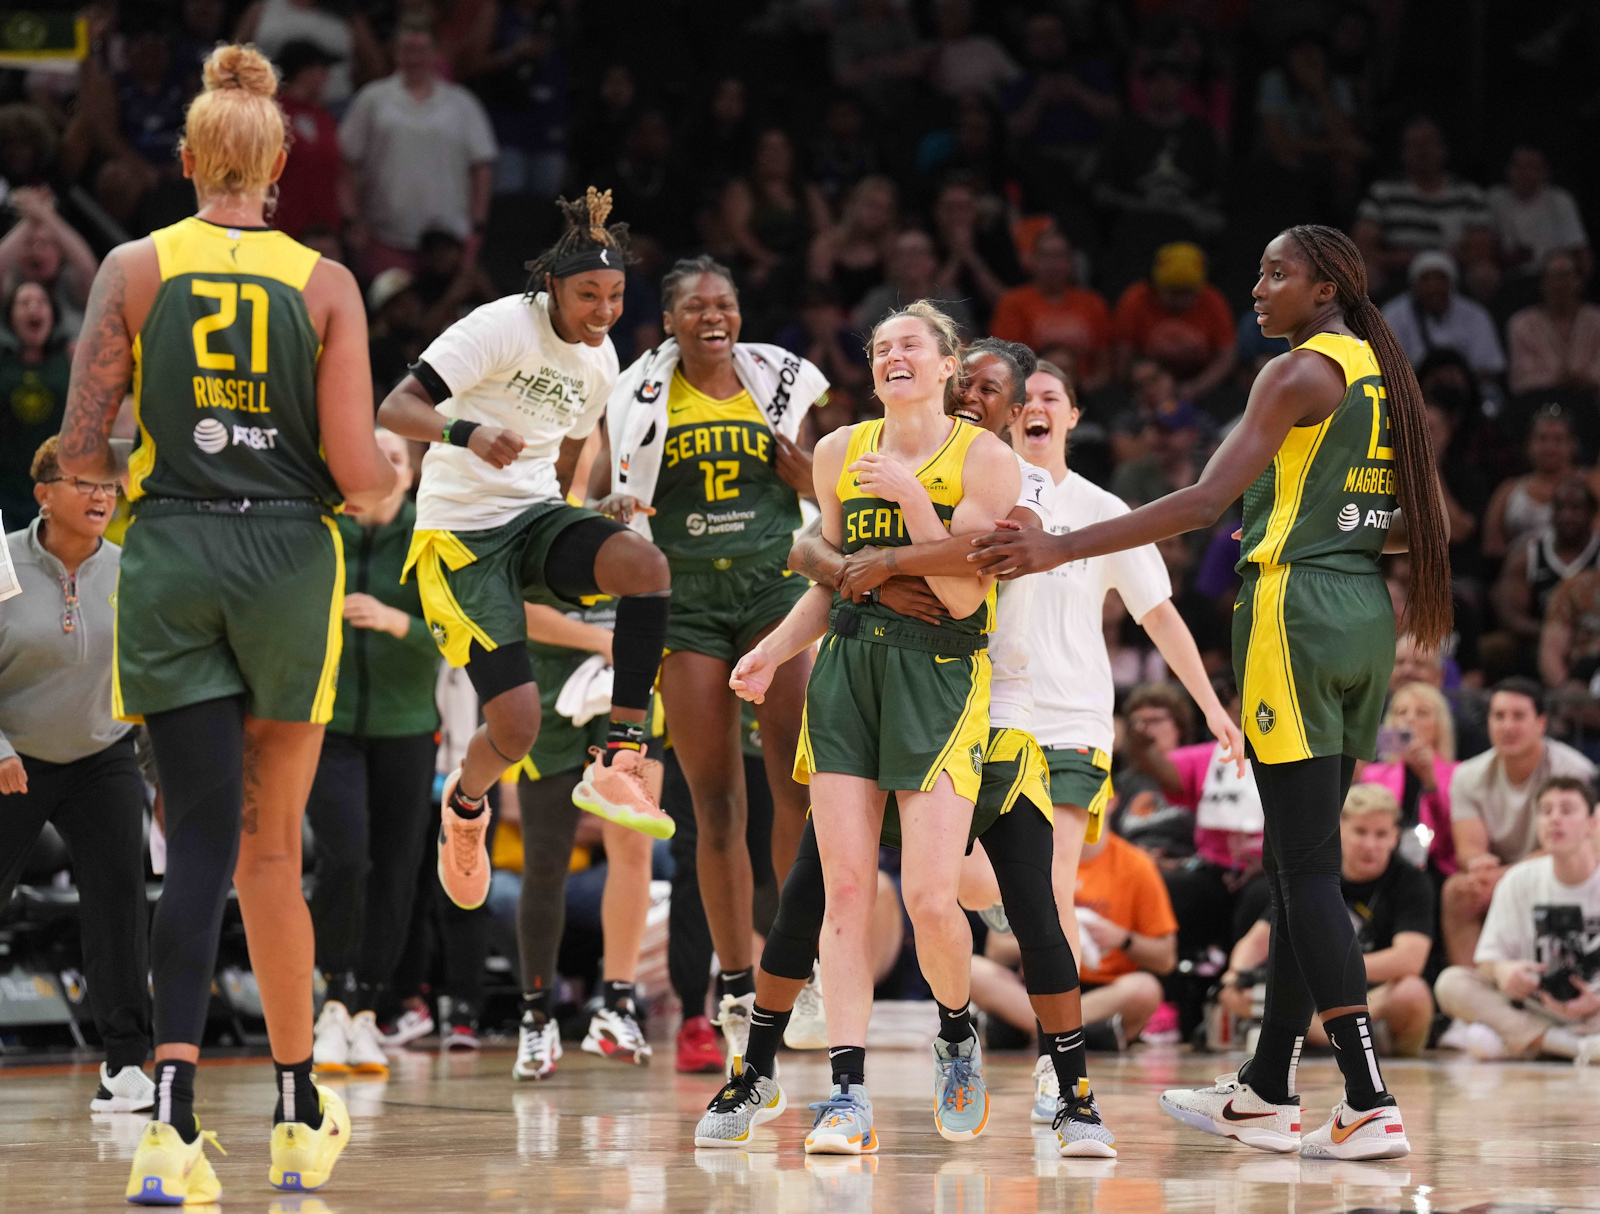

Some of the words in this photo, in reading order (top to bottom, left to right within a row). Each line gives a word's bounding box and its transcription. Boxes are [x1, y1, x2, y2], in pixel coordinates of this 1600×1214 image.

[191, 278, 270, 374] 21
[191, 374, 271, 414] RUSSELL
[231, 424, 279, 450] AT&T
[664, 425, 770, 469] SEATTLE
[698, 459, 741, 503] 12
[1363, 509, 1393, 530] AT&T
